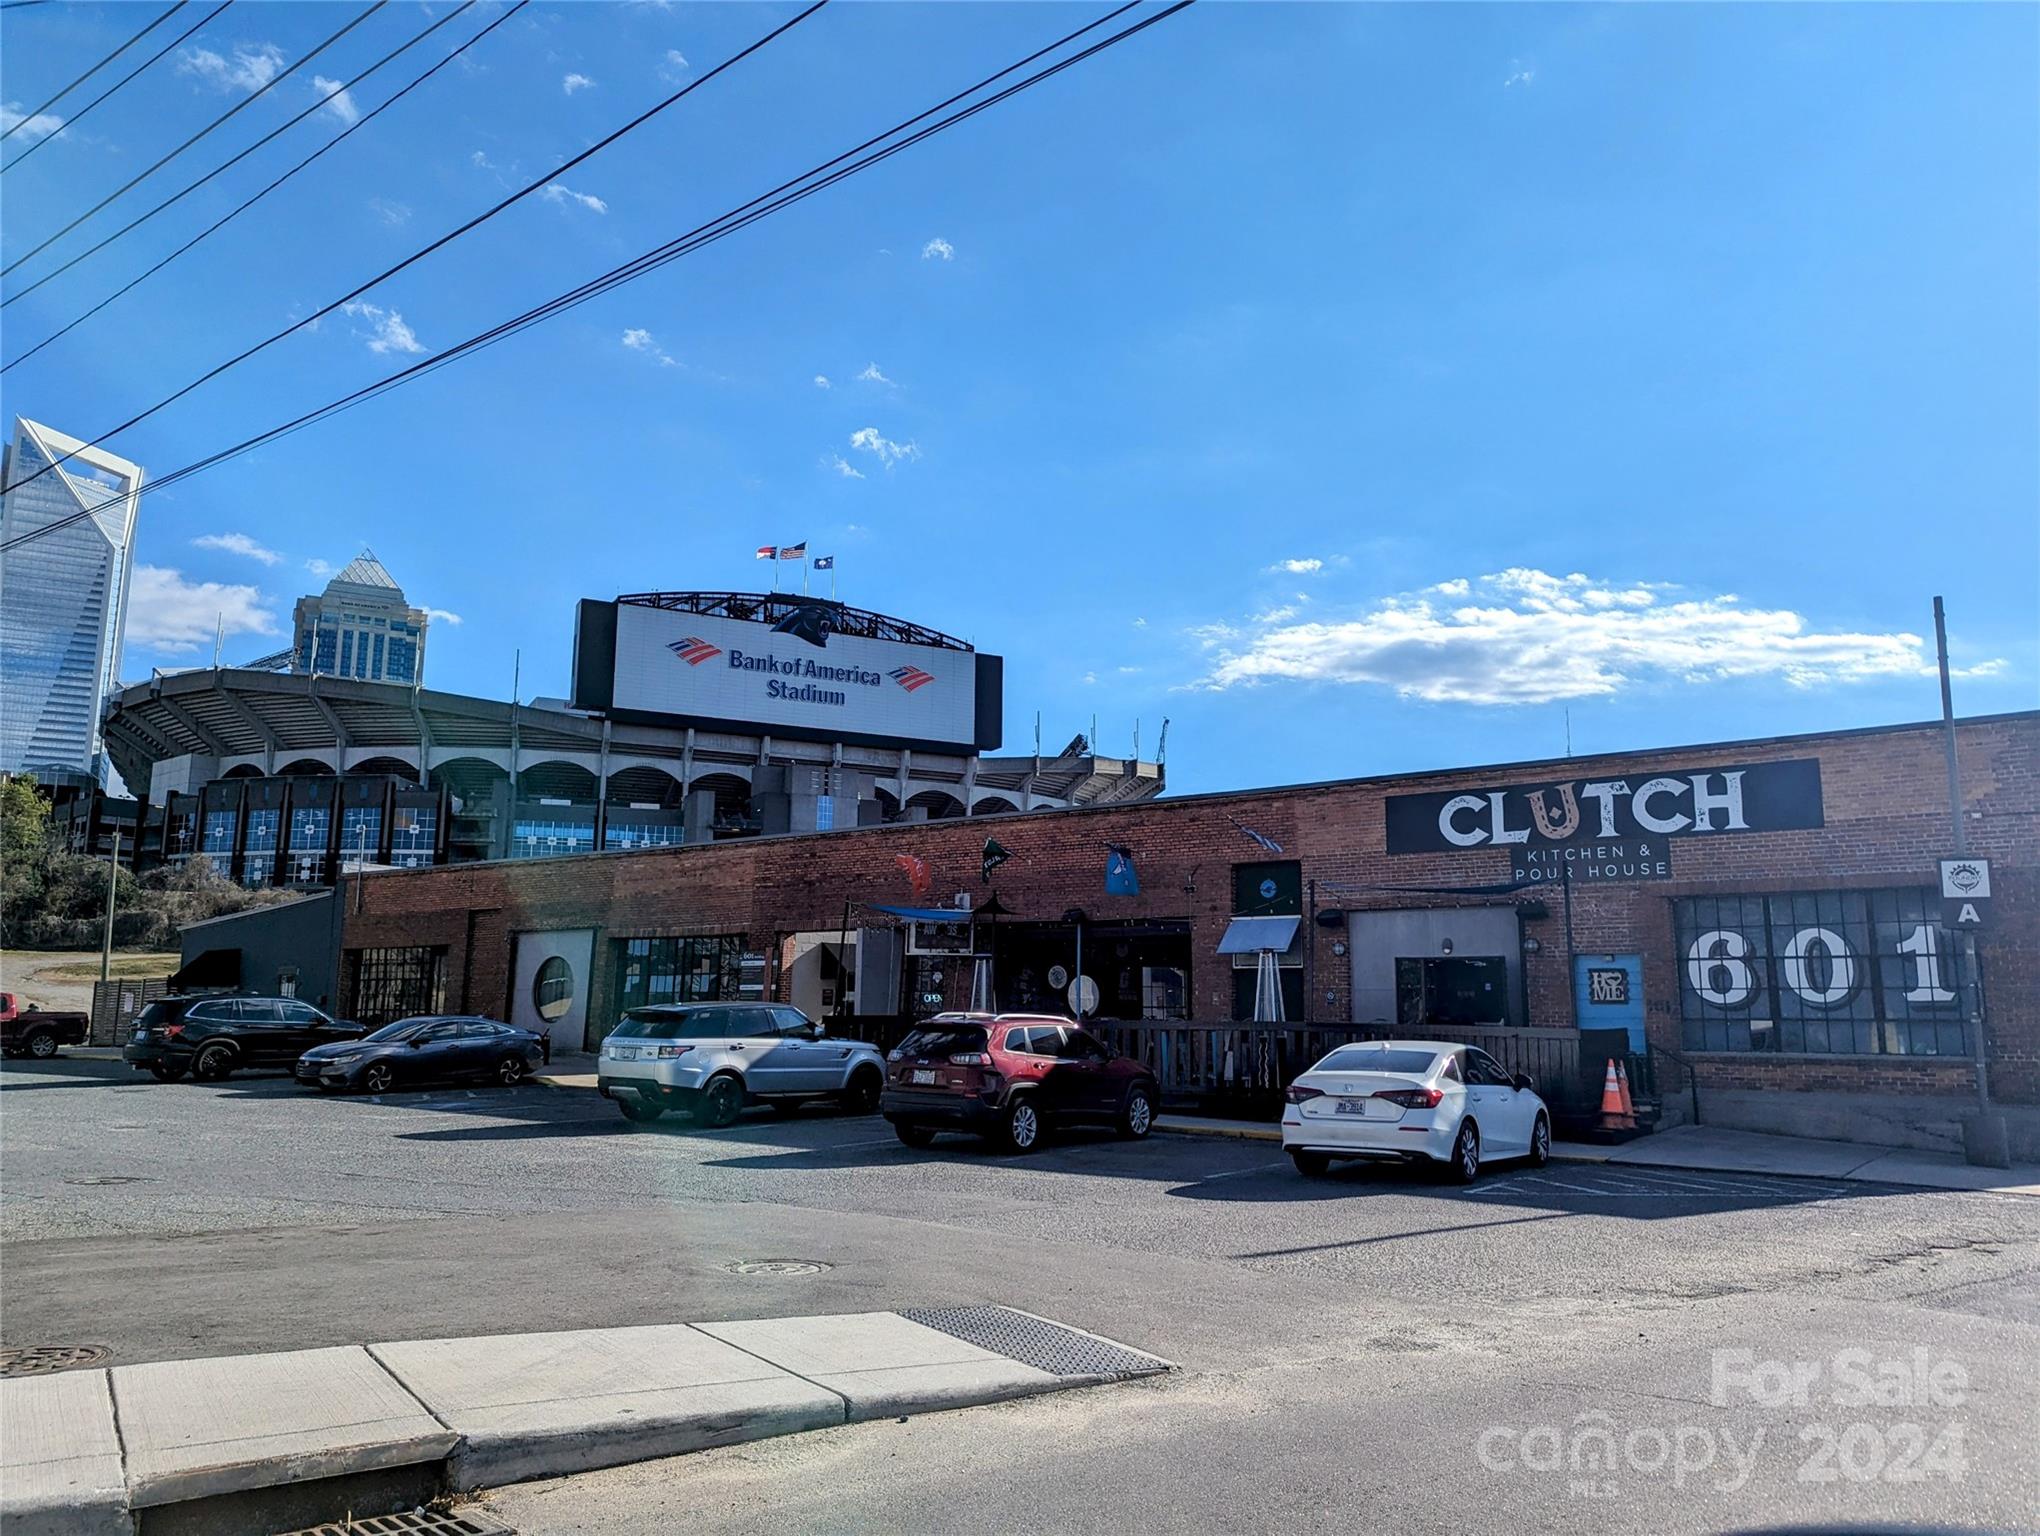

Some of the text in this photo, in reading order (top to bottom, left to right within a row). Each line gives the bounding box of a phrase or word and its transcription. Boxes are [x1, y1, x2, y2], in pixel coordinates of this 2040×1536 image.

[729, 650, 881, 686] Bank of America
[767, 679, 845, 706] Stadium
[1438, 770, 1751, 848] CLUTCH
[1527, 844, 1650, 862] KITCHEN &
[1589, 862, 1666, 877] HOUSE
[1958, 903, 1981, 922] A
[1688, 925, 1956, 1005] 601
